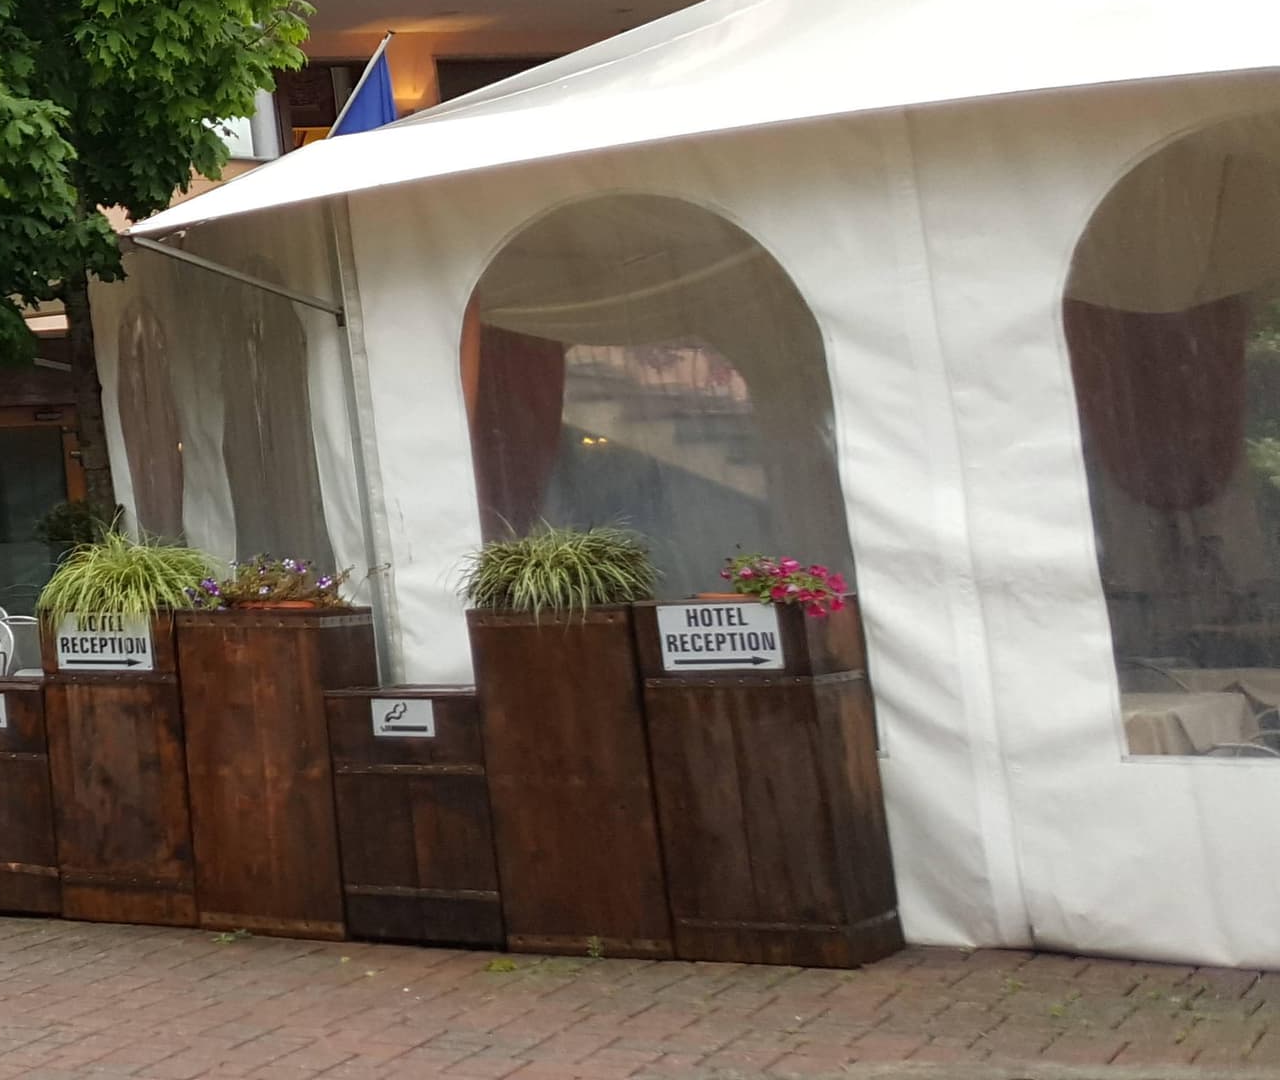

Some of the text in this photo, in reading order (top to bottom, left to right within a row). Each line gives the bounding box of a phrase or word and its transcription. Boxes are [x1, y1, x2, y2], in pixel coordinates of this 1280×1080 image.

[685, 607, 749, 628] HOTEL
[60, 636, 147, 654] RECEPTION
[665, 631, 777, 653] RECEPTION
